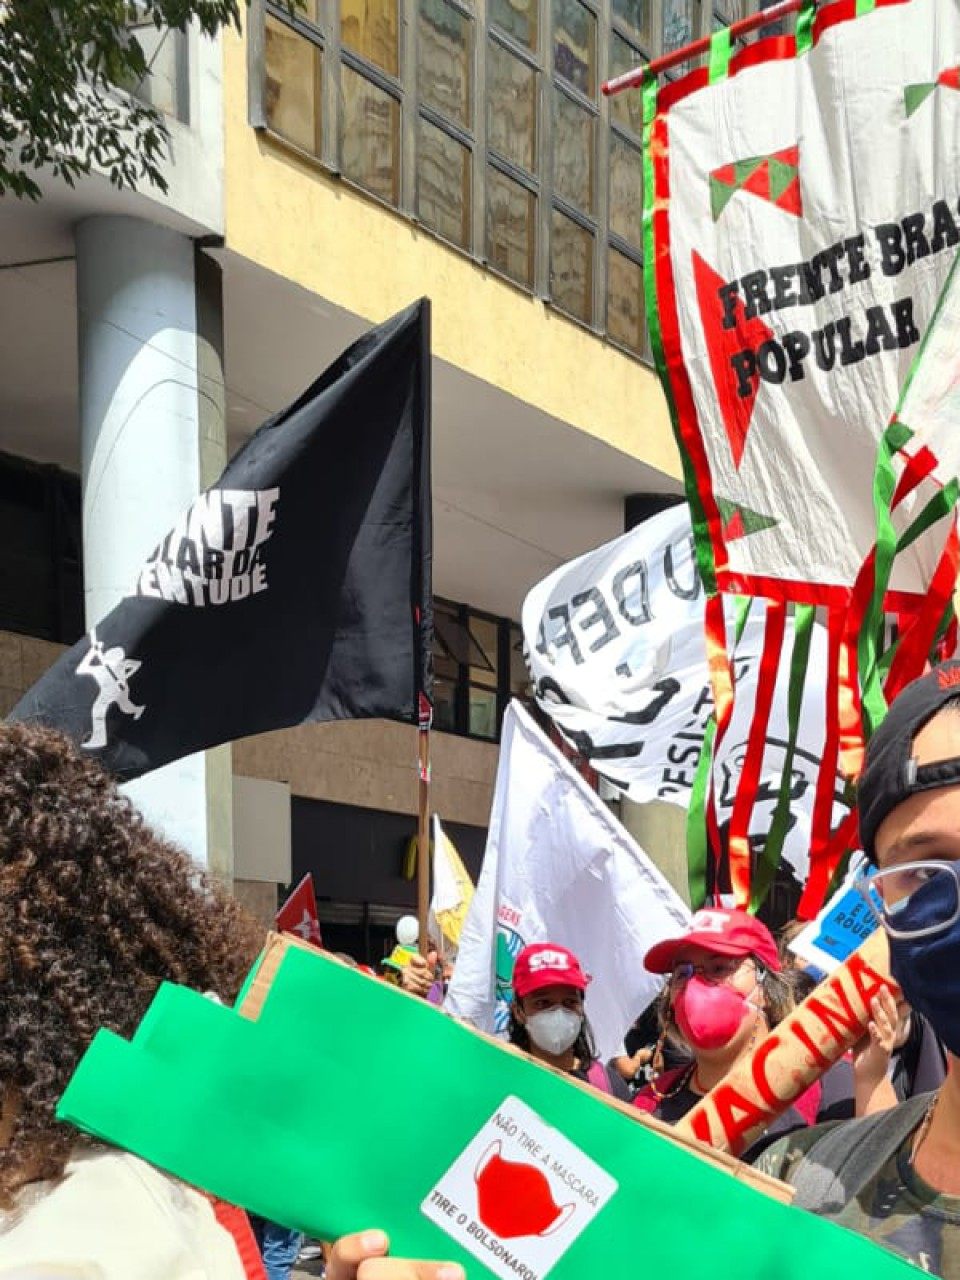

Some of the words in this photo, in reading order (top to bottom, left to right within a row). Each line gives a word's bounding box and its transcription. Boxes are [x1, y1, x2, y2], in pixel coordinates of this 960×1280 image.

[718, 233, 870, 330] FRENTE
[731, 296, 920, 398] POPULAR
[131, 564, 269, 607] ENTUDE
[493, 1112, 518, 1138] NÃO
[519, 1132, 542, 1155] TIRE
[541, 1153, 551, 1166] A
[430, 1190, 459, 1217] TIRE
[456, 1212, 468, 1226] O
